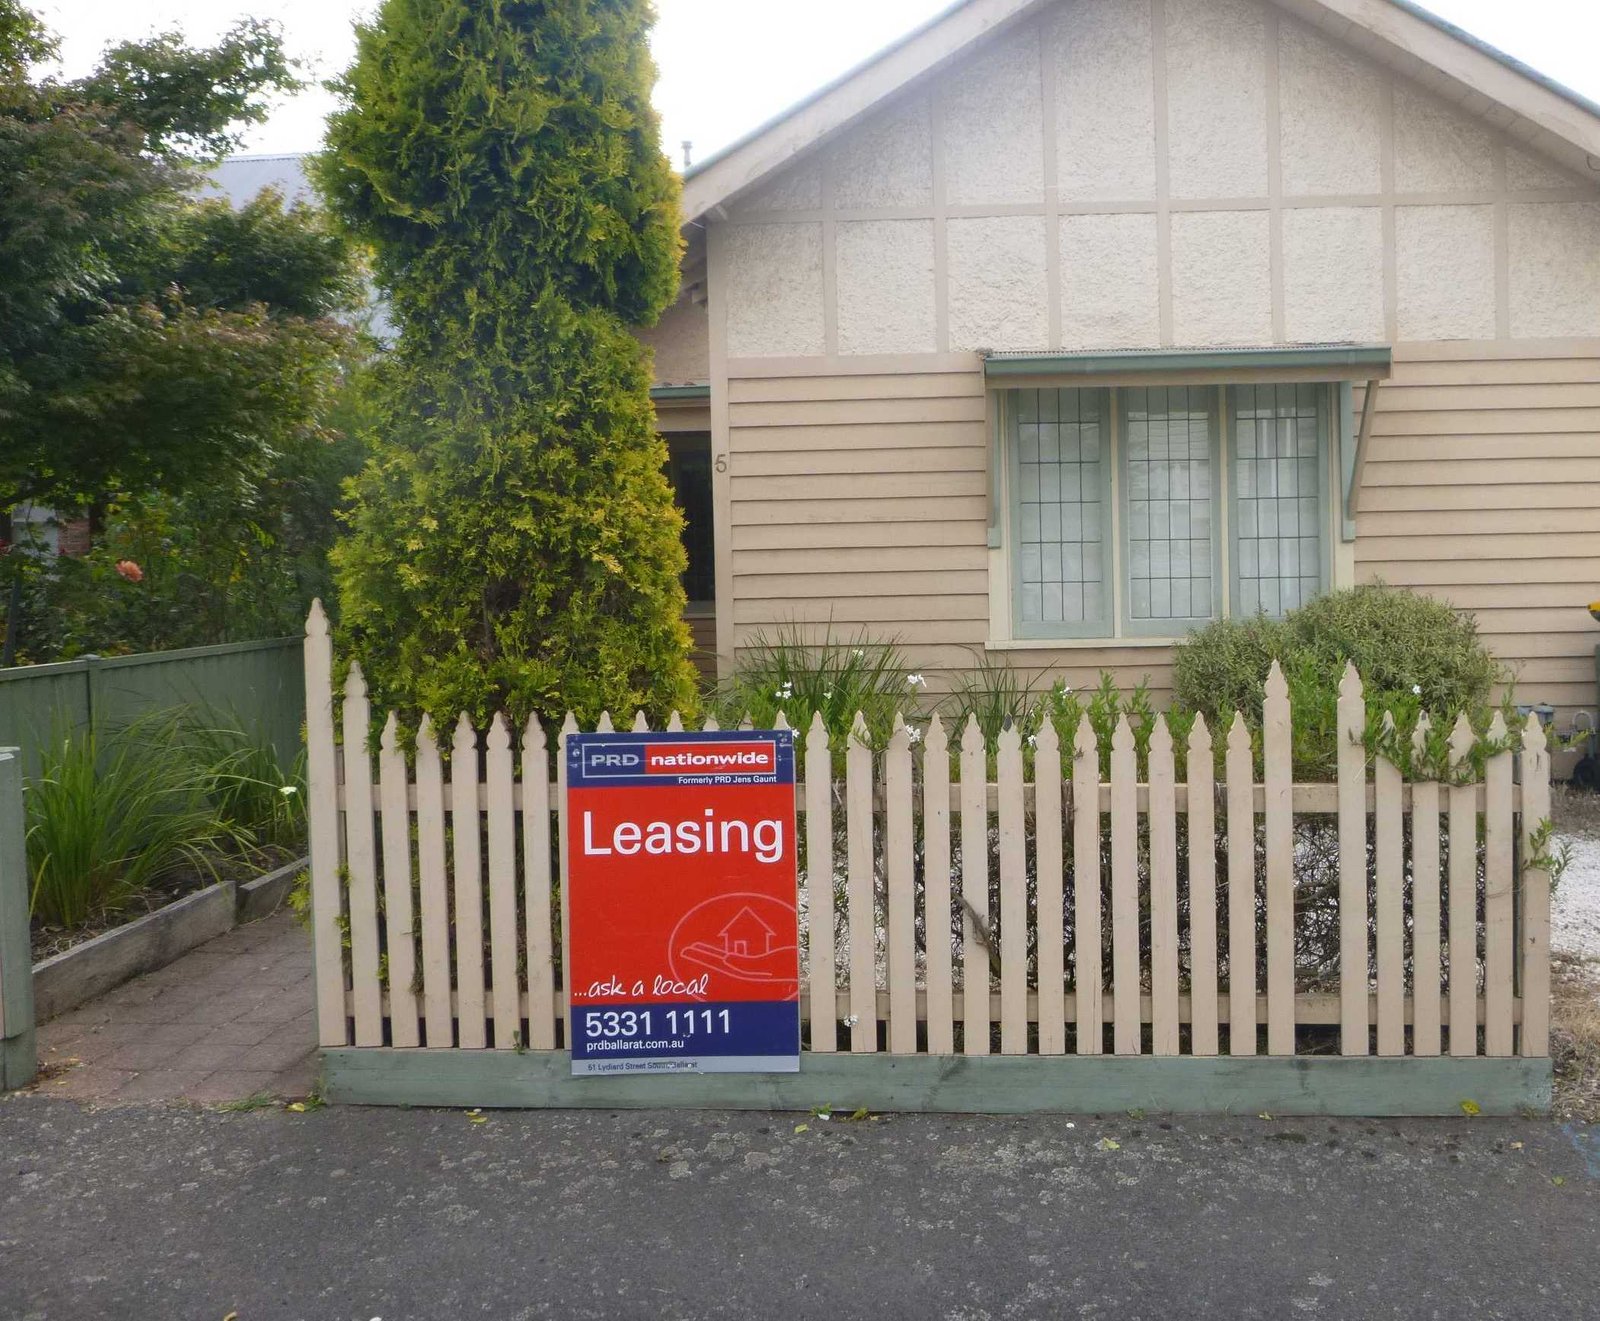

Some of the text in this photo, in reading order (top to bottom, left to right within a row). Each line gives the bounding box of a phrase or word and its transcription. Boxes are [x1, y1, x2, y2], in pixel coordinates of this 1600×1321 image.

[714, 453, 728, 473] 5
[591, 751, 769, 767] PRD nationwide
[678, 775, 777, 785] Formerly PRD Jens Gaunt
[584, 809, 783, 864] Leasing
[631, 978, 646, 997] a
[652, 973, 709, 996] local
[585, 1009, 731, 1037] 5331 1111
[586, 1039, 685, 1052] prdballarat.com.au
[597, 1062, 625, 1072] Lydiard
[625, 1062, 647, 1070] Street
